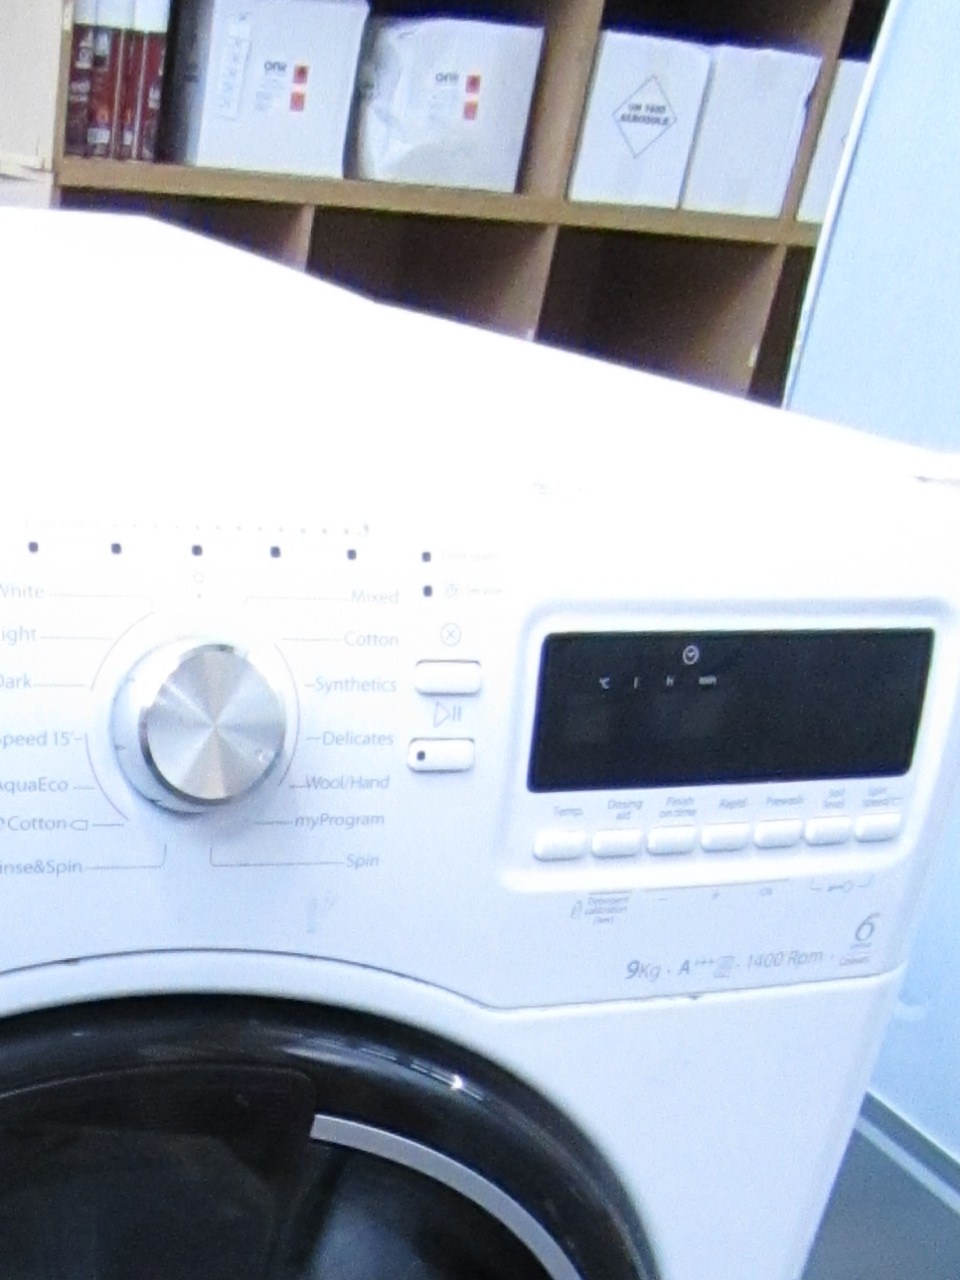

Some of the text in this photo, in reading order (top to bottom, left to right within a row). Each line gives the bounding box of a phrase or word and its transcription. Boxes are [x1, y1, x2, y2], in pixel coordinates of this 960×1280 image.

[350, 590, 400, 604] Mixed
[344, 631, 400, 648] Cotton
[314, 675, 398, 693] Synthetics
[321, 731, 395, 747] Delicates
[305, 775, 391, 791] Wool/Hand
[294, 812, 386, 831] myProgram
[345, 854, 380, 870] Spin
[746, 953, 785, 969] 1400
[788, 951, 824, 967] Rpm
